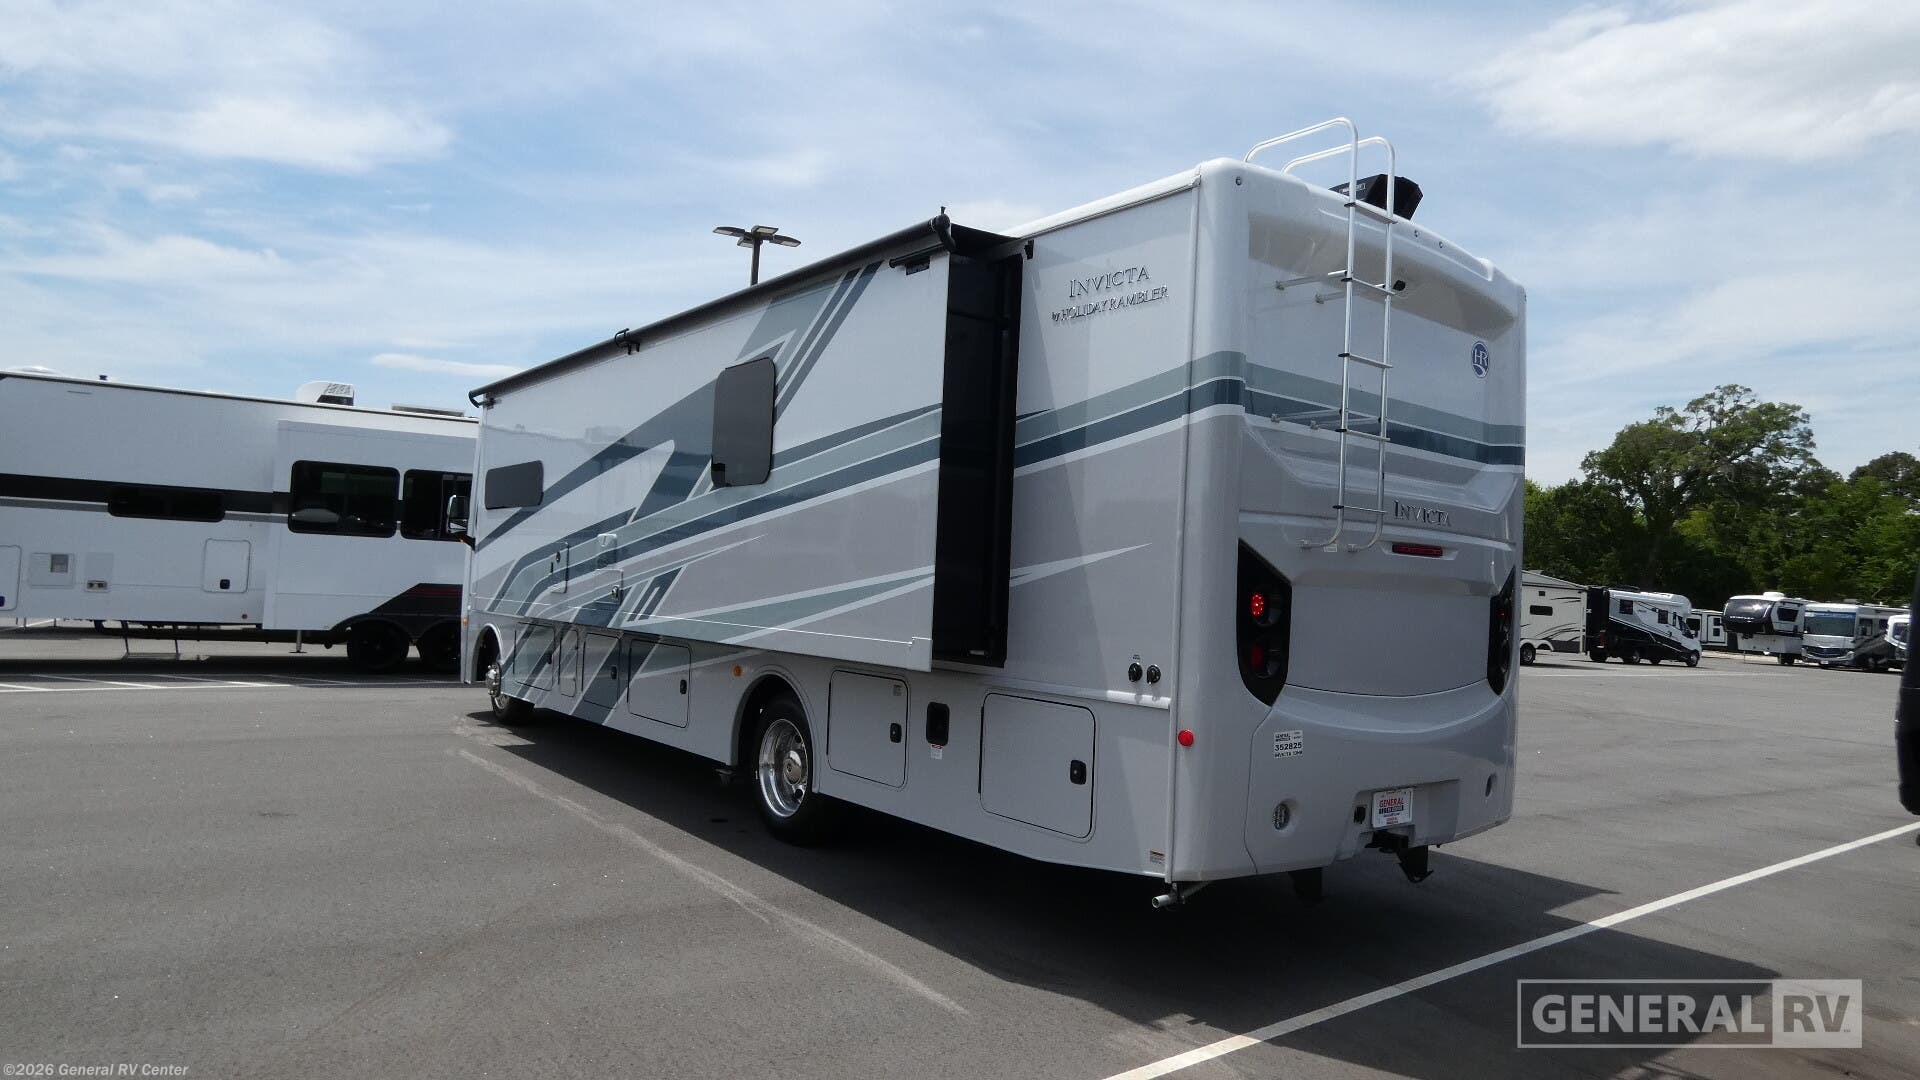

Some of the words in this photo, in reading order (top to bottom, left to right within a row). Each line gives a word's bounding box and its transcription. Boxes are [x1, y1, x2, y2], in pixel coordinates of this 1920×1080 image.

[1069, 266, 1150, 298] INVICTA
[1393, 500, 1452, 527] INVICTA
[1274, 741, 1302, 752] 352825
